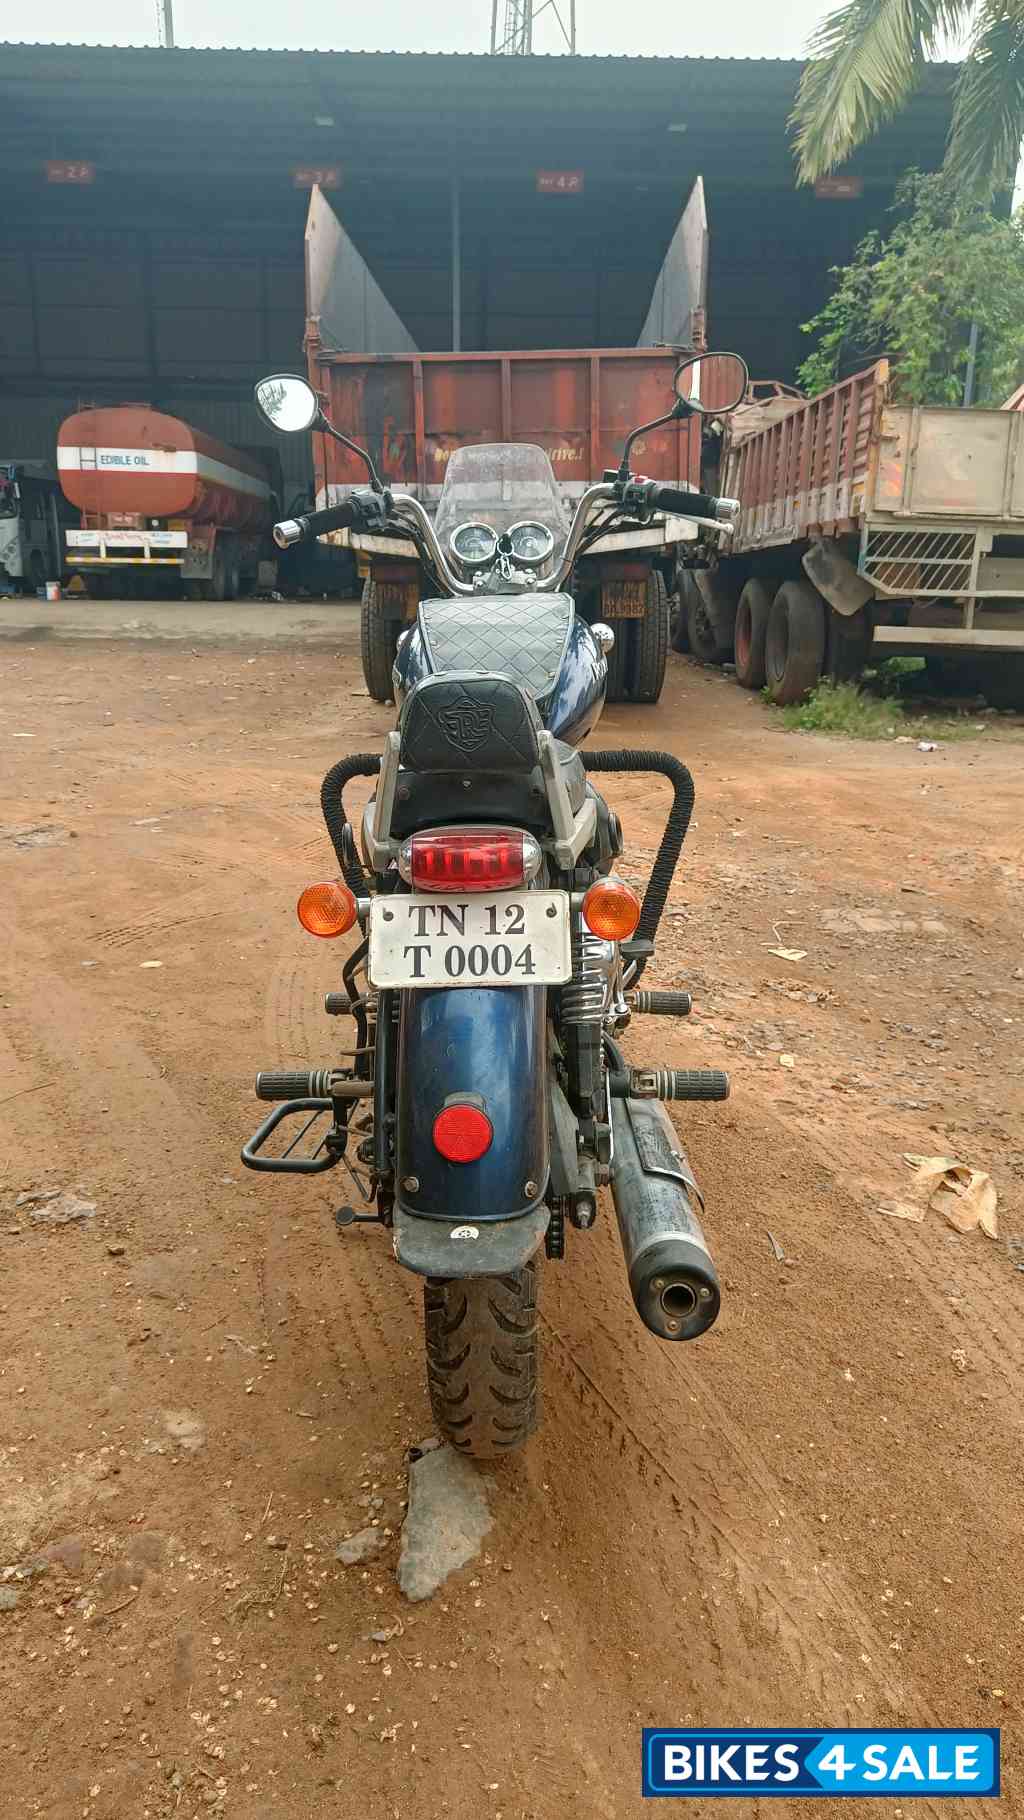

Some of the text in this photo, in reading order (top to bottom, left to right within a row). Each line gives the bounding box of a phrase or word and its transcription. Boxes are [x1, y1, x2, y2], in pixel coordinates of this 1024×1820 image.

[100, 455, 151, 466] EDIBLE OIL
[408, 904, 526, 937] TN 12
[403, 943, 537, 978] T 0004
